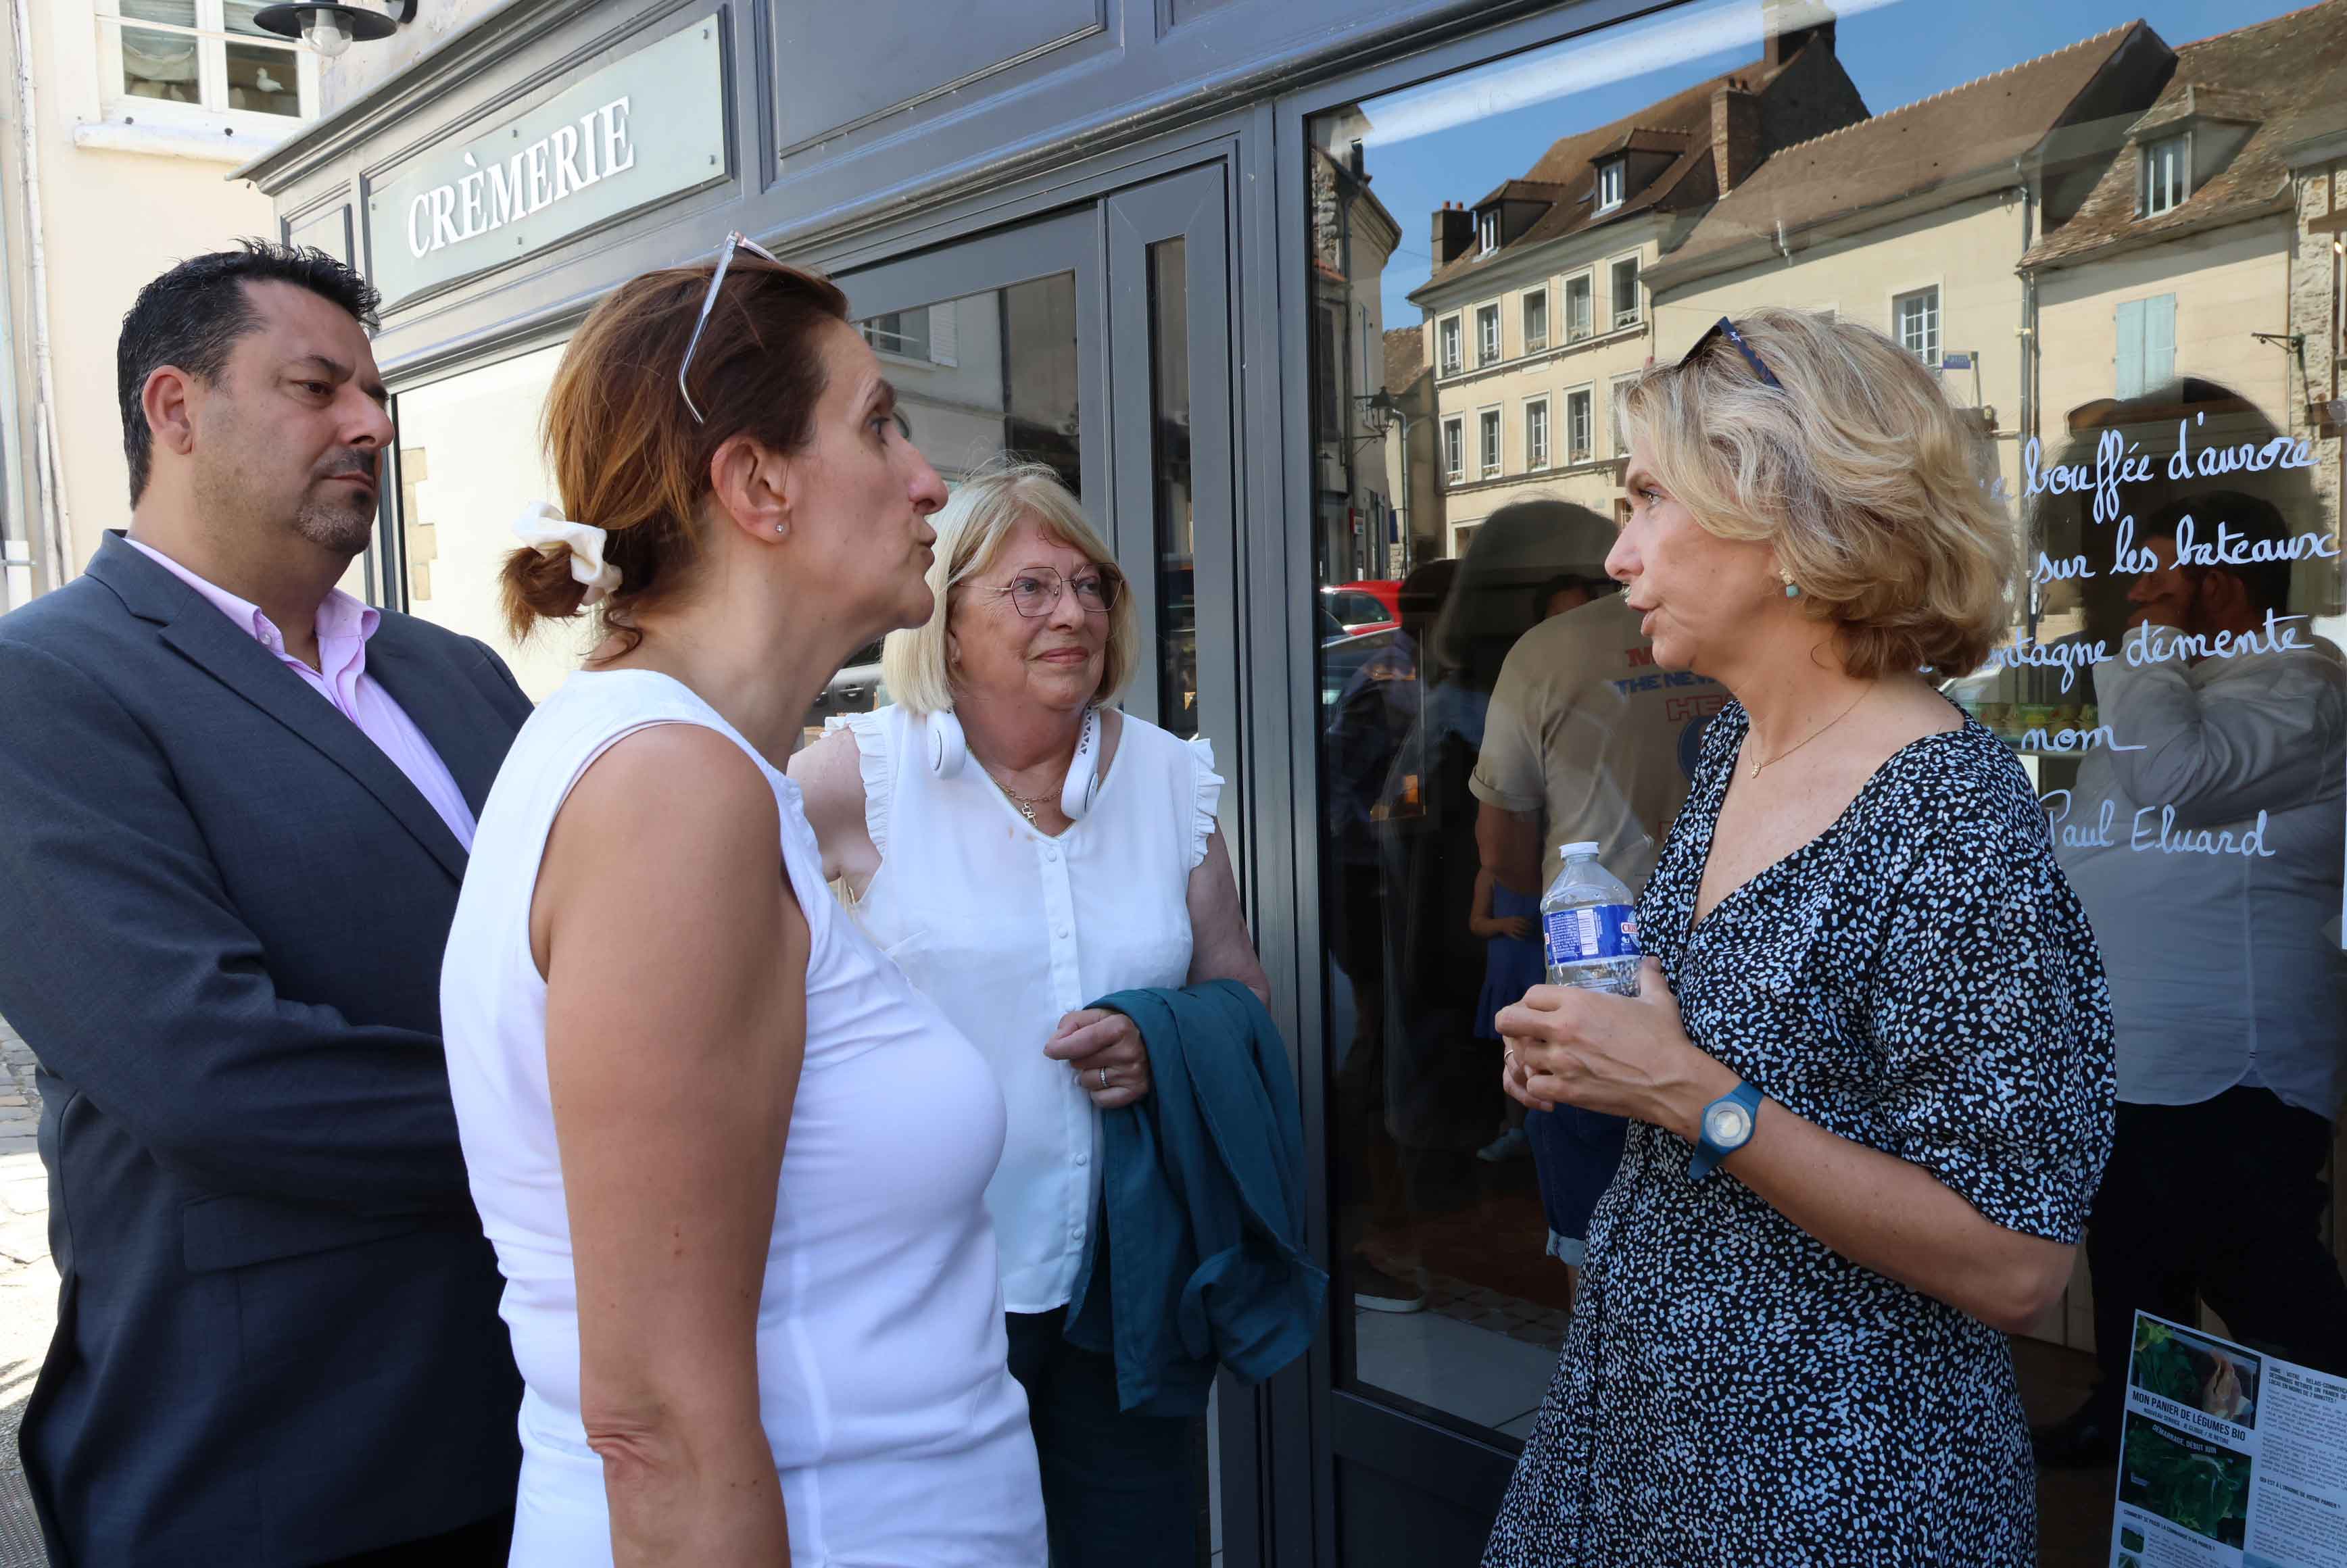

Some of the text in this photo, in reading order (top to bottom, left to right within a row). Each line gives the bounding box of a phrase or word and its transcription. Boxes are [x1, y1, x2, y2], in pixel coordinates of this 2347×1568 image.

[407, 95, 635, 259] CRÈMERIE
[2023, 411, 2320, 524] bouffée d'aurore
[2033, 514, 2341, 584] sur les bateaux
[2126, 608, 2315, 667] démente
[2021, 724, 2148, 752] nom
[2039, 789, 2276, 857] Paul Eluard
[2132, 1390, 2246, 1441] MON PANIER DE LÉGUMES BIO
